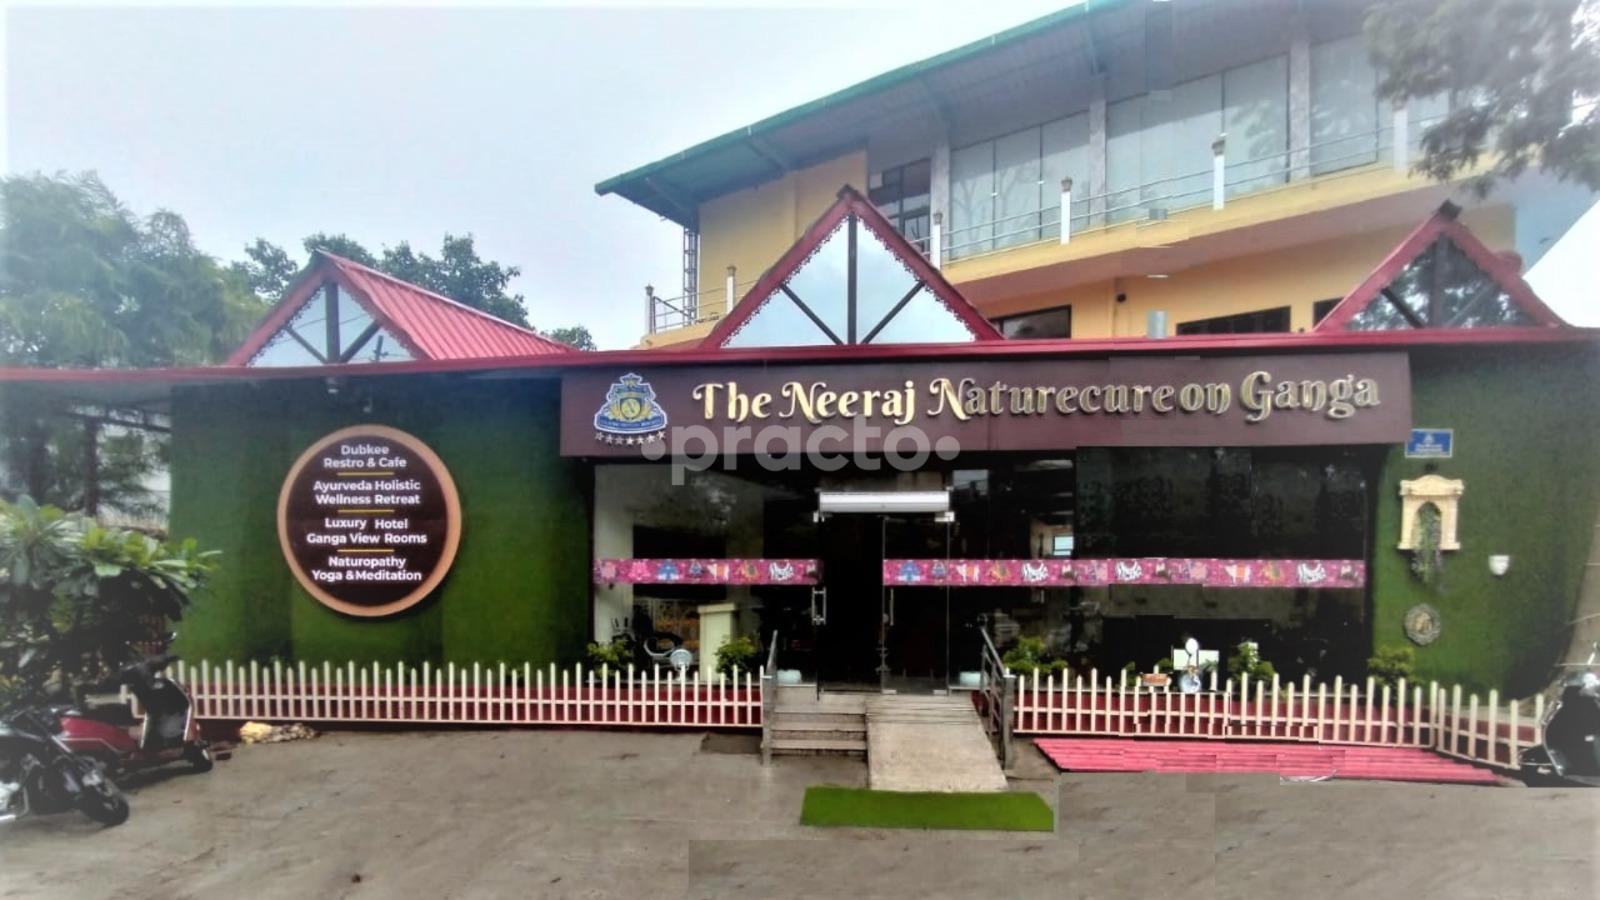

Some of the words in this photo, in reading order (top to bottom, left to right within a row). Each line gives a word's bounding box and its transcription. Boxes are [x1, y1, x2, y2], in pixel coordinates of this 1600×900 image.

[692, 381, 772, 423] The
[778, 380, 916, 425] Neeraj
[927, 377, 1175, 421] Naturecure
[1178, 382, 1231, 414] on
[1240, 370, 1380, 422] Ganga
[341, 444, 390, 455] Dubkee
[323, 457, 364, 469] Restro
[366, 457, 376, 469] &
[378, 456, 407, 468] Cafe
[313, 480, 373, 494] Ayurveda
[375, 479, 421, 491] Holistic
[315, 494, 371, 505] Wellness
[374, 493, 421, 505] Retreat
[324, 518, 367, 530] Luxury
[374, 518, 409, 529] Hotel
[306, 533, 347, 546] Ganga
[349, 533, 381, 544] View
[384, 533, 428, 544] Rooms
[328, 556, 407, 569] Naturopathy
[311, 570, 343, 583] Yoga
[345, 570, 354, 581] &
[355, 569, 422, 581] Meditation
